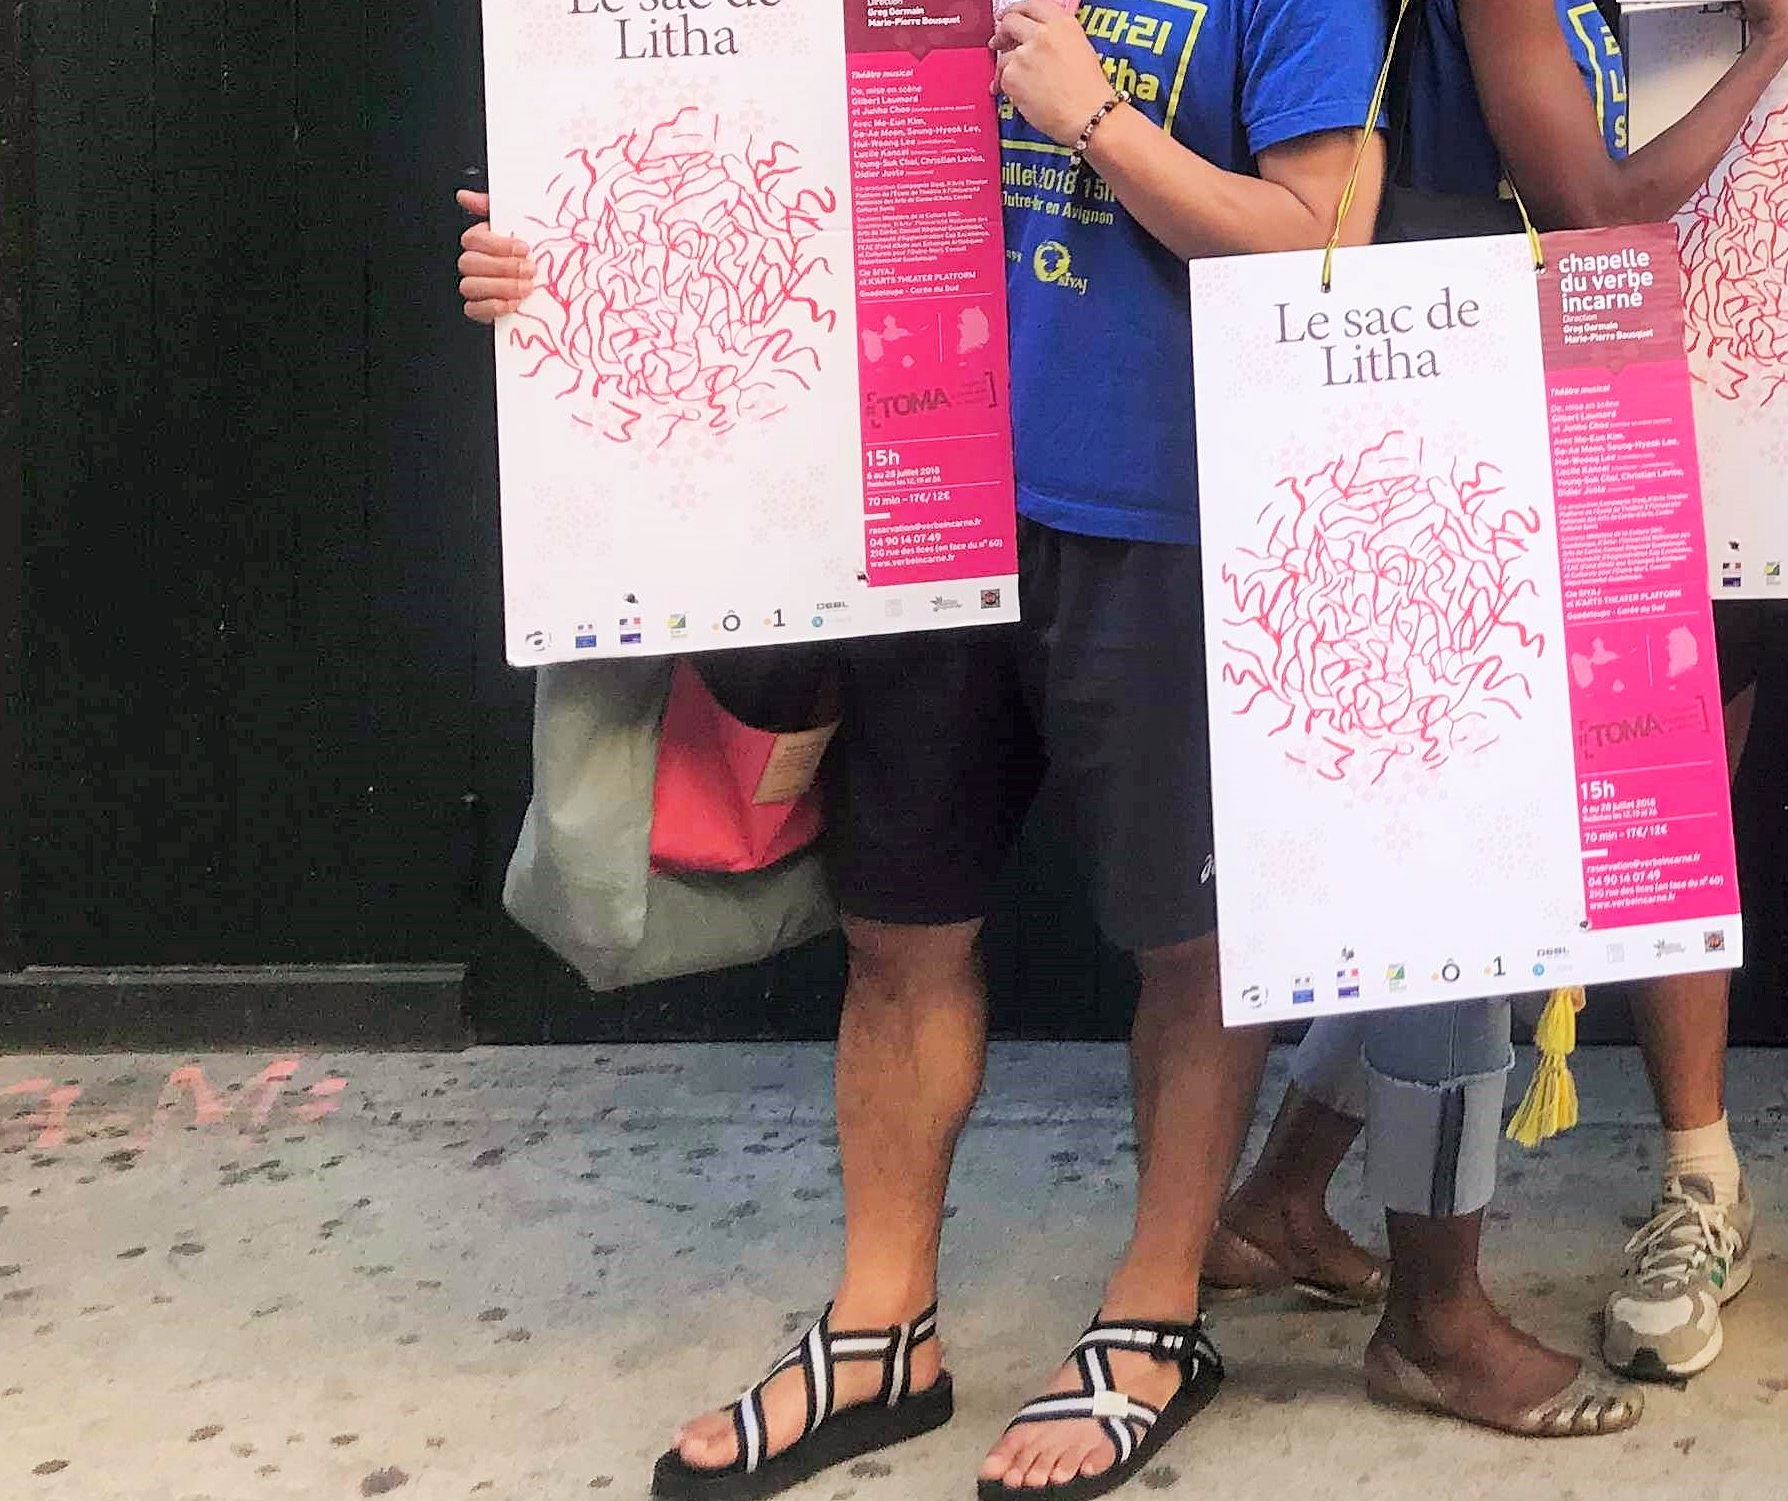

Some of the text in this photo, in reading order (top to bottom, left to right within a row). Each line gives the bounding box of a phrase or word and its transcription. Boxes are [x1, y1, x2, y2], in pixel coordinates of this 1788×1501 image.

[614, 11, 739, 60] Litha
[1557, 246, 1651, 277] chapelle
[1559, 266, 1654, 293] du verbe
[1273, 284, 1480, 344] Le sac de
[1561, 286, 1644, 313] incarné
[1320, 333, 1441, 386] Litha
[876, 386, 952, 419] TOMA
[866, 447, 900, 468] 15h
[867, 495, 880, 507] 70
[881, 494, 901, 506] min
[869, 532, 941, 547] 04 90 14 07 49
[1588, 711, 1665, 748] TOMA
[1580, 778, 1615, 801] 15h
